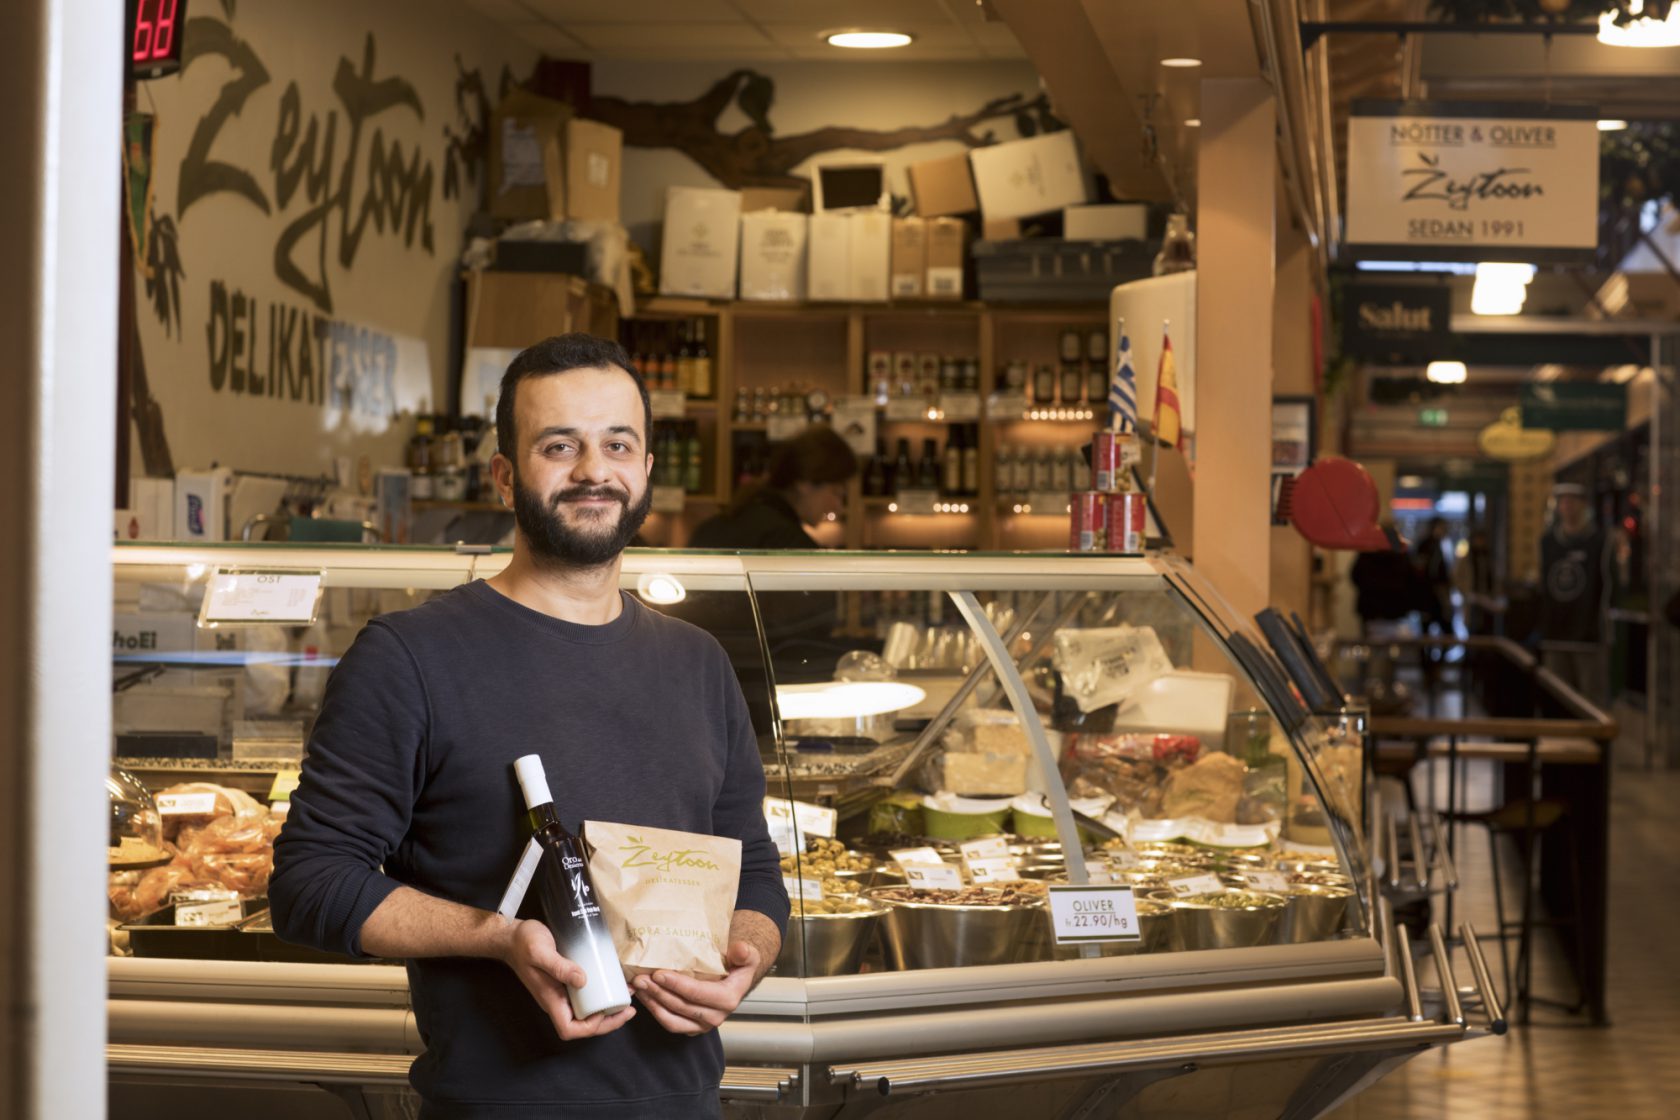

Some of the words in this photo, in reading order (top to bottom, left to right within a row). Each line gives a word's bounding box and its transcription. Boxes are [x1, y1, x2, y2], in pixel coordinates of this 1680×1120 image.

[1470, 126, 1483, 142] &
[1489, 126, 1556, 143] OLIVER
[1408, 218, 1473, 237] SEDAN
[1481, 220, 1525, 237] 1991
[1072, 899, 1114, 912] OLIVER
